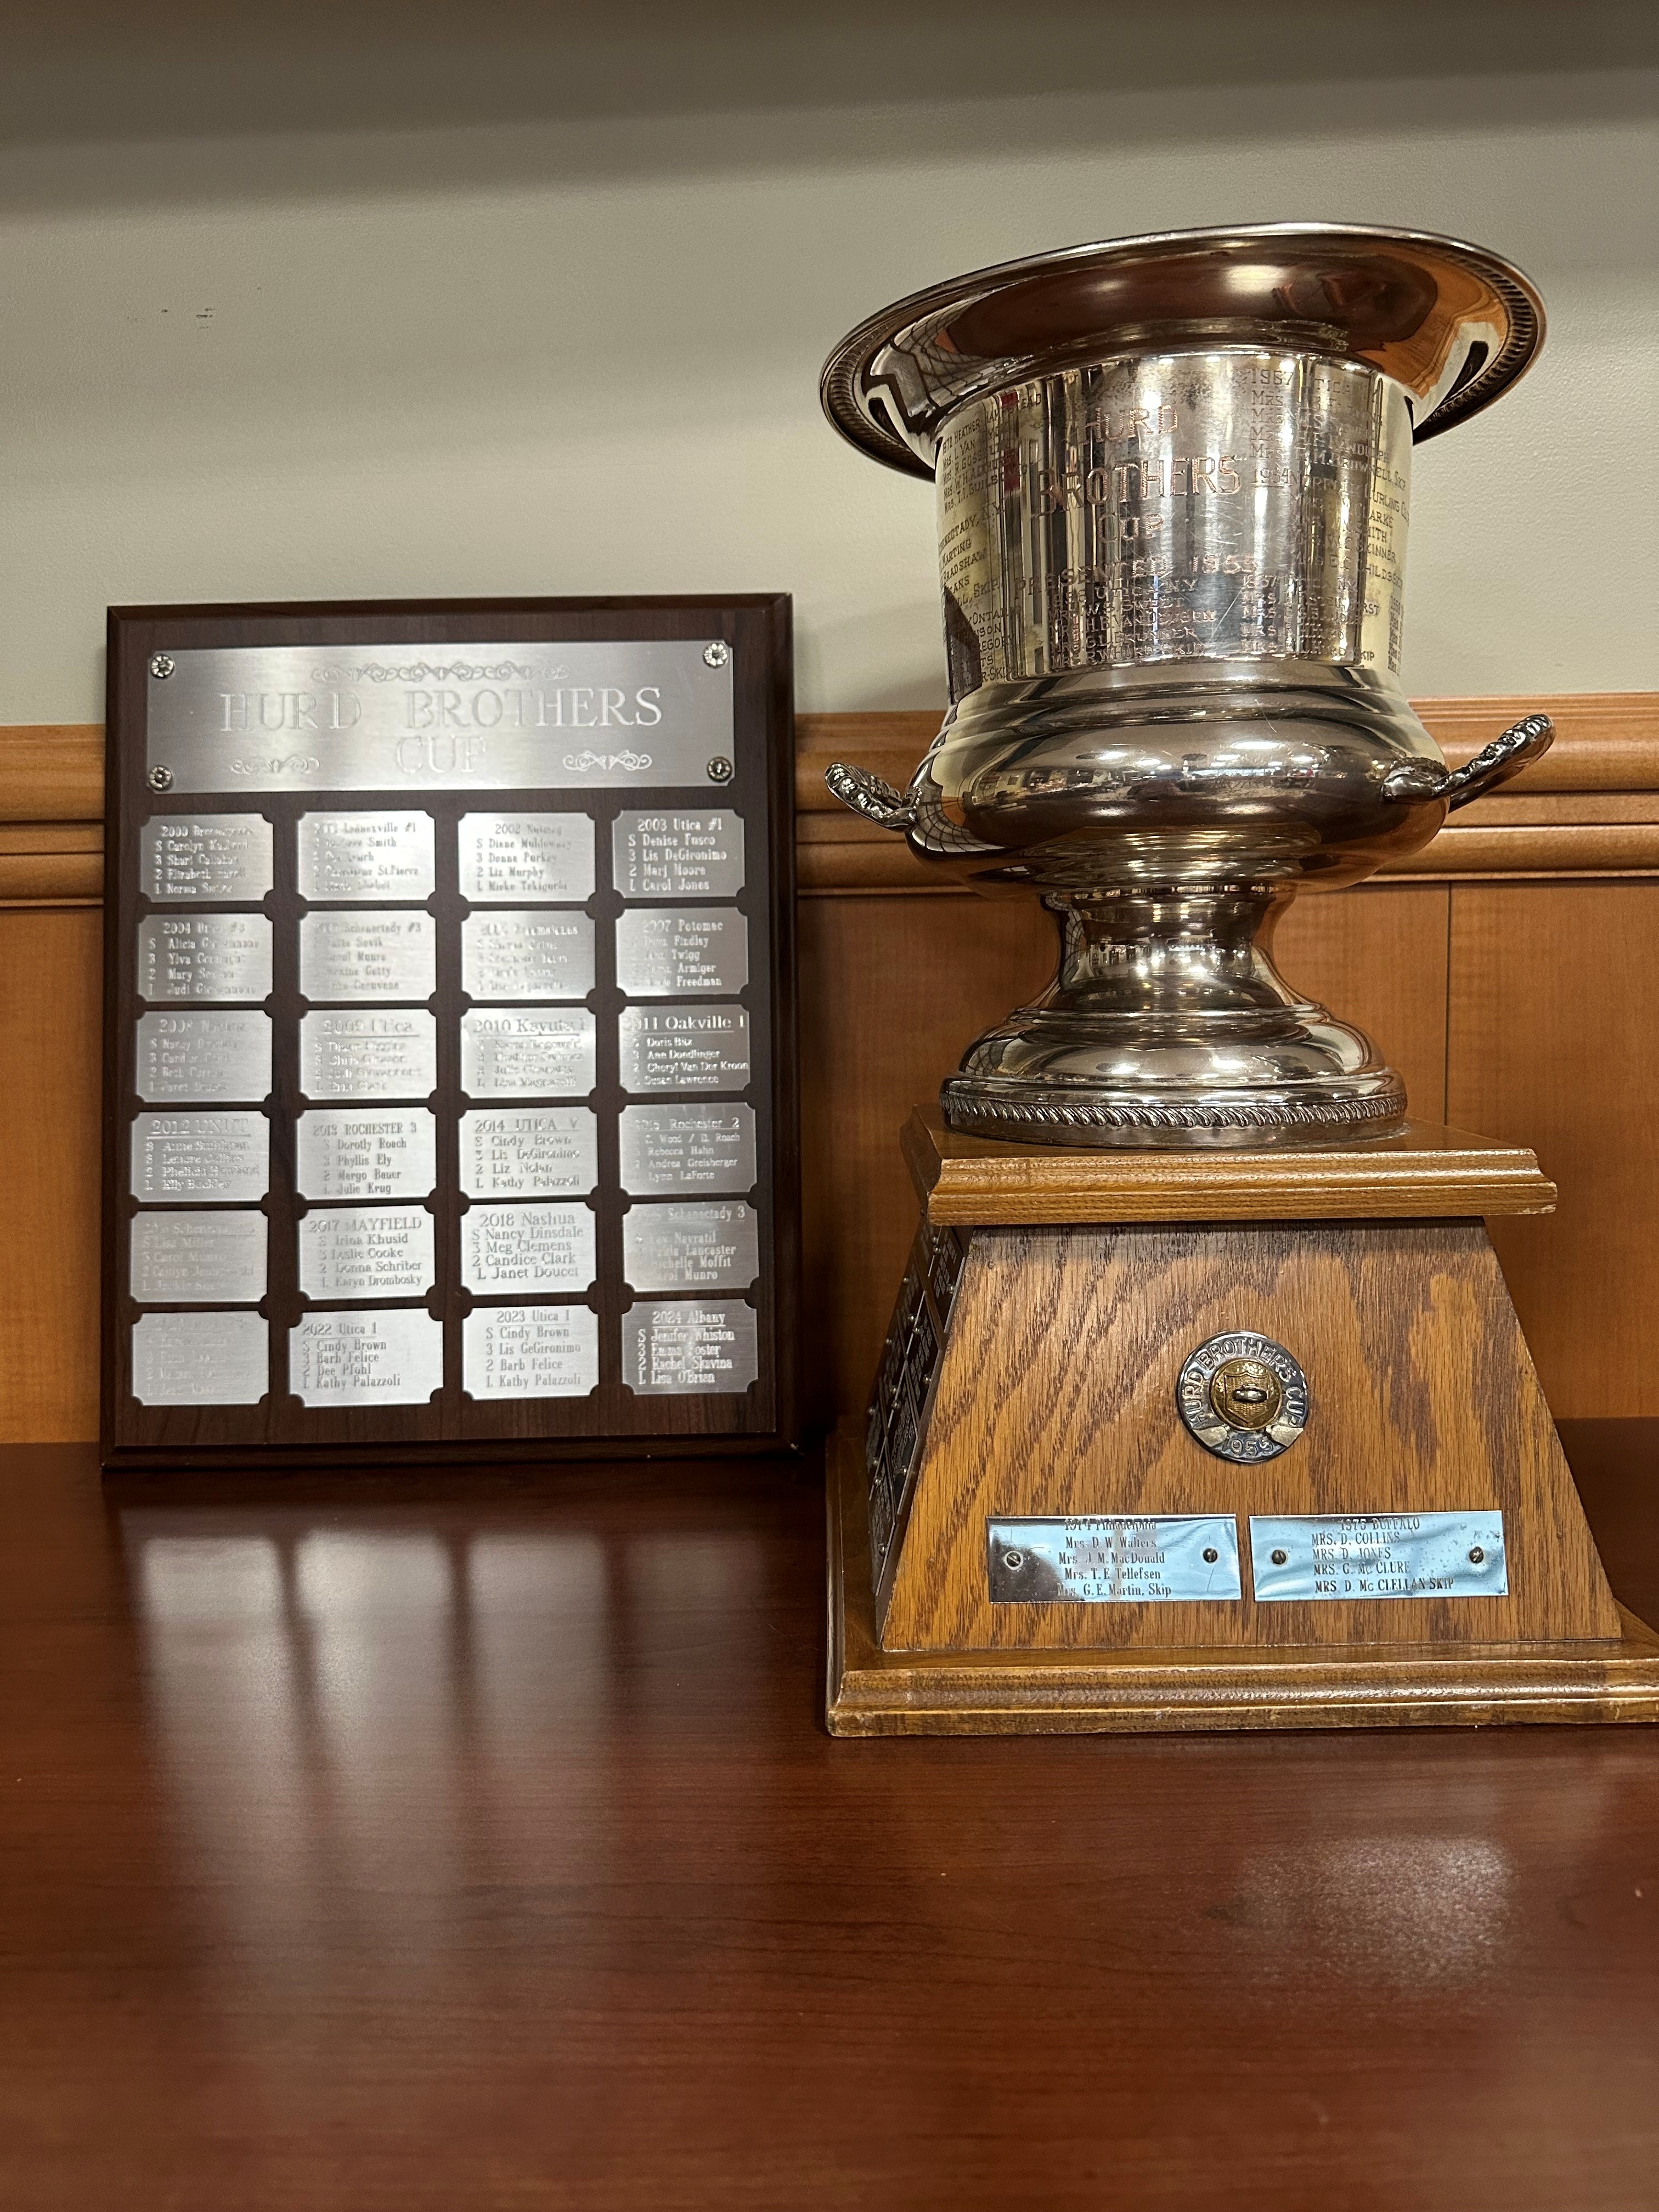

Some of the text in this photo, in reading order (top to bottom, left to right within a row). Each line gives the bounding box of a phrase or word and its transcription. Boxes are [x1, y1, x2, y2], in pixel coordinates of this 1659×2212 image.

[1081, 405, 1178, 445] HURD
[1031, 454, 1242, 518] BROTHERS
[1099, 512, 1164, 542] CUP
[1014, 552, 1259, 599] PRESENTED 1955
[219, 687, 662, 732] HURD BROTHERS
[396, 734, 488, 774] CUP
[161, 825, 189, 838] 2000
[494, 823, 521, 834] 2002
[637, 817, 723, 832] 2003 Utica #1
[368, 837, 397, 848] Smith
[489, 838, 515, 849] Diane
[642, 833, 716, 847] Denise Fusco
[489, 852, 518, 863] Donna
[642, 848, 727, 862] Lis DeGironimo
[489, 866, 545, 881] Liz Murphy
[643, 862, 706, 878] Marj Moore
[642, 877, 710, 891] Carol Jones
[678, 918, 724, 932] Potomac
[674, 934, 709, 949] Findlay
[671, 949, 701, 962] Twigg
[168, 967, 193, 982] Mary
[678, 962, 716, 975] Armiger
[676, 975, 723, 987] Freedman
[473, 1019, 512, 1033] 2010
[665, 1015, 732, 1030] Oakville
[646, 1037, 673, 1047] Doris
[647, 1051, 667, 1059] Ann
[680, 1062, 699, 1072] Van
[700, 1062, 718, 1071] Der
[720, 1060, 750, 1070] Kroon
[674, 1074, 719, 1085] Lawrence
[345, 1122, 403, 1136] ROCHESTER
[475, 1118, 558, 1132] 2014 UTICA
[669, 1118, 723, 1130] Rochester
[379, 1137, 407, 1149] Roach
[492, 1134, 572, 1148] Cindy Brown
[659, 1133, 682, 1144] Wood
[492, 1147, 580, 1161] Lis DeGironimo
[648, 1146, 715, 1156] Rebecca Hahn
[337, 1153, 392, 1167] Phyllis Ely
[648, 1159, 681, 1169] Andrea
[493, 1161, 553, 1174] Liz Nolan
[338, 1168, 402, 1183] Margo Bauer
[492, 1175, 580, 1189] Kathy Palazzoli
[680, 1170, 715, 1180] LaForte
[367, 1182, 392, 1195] Krug
[479, 1211, 575, 1227] 2018 Nashua
[668, 1205, 732, 1222] Schenectady
[308, 1216, 422, 1233] 2017 MAYFIELD
[335, 1232, 409, 1246] Irina Khusid
[486, 1226, 584, 1240] Nancy Dinsdale
[674, 1230, 716, 1244] Navratil
[331, 1247, 404, 1260] Leslie Cooke
[486, 1239, 572, 1255] Meg Clemens
[685, 1243, 737, 1256] Lancaster
[485, 1251, 577, 1266] Candice Clark
[335, 1260, 422, 1273] Donna Schriber
[492, 1265, 579, 1279] Janet Doucet
[685, 1267, 718, 1280] Munro
[368, 1273, 422, 1286] Drombosky
[496, 1309, 558, 1323] 2023 Utica
[652, 1310, 726, 1325] 2024 Albany
[302, 1322, 365, 1336] 2022 Utica
[499, 1325, 570, 1341] Cindy Brown
[317, 1338, 387, 1355] Cindy Brown
[499, 1342, 515, 1355] Lis
[651, 1342, 683, 1357] Emma
[317, 1350, 380, 1364] Barb Felice
[500, 1357, 563, 1371] Barb Felice
[652, 1355, 733, 1370] Rachel Skavina
[317, 1364, 336, 1376] Dee
[651, 1369, 715, 1384] Lisa O'Brien
[317, 1373, 401, 1391] Kathy Palazzoli
[499, 1373, 582, 1390] Kathy Palazzoli
[1182, 1337, 1305, 1430] HURD BROTHERS CUP
[1221, 1436, 1274, 1457] 1955
[1096, 1518, 1157, 1533] Philadelphia
[1371, 1516, 1420, 1531] BUFFALO
[1119, 1536, 1157, 1549] Walters
[1311, 1531, 1400, 1546] MRS. D. COLLINS
[1110, 1551, 1165, 1564] MacDonald
[1357, 1546, 1391, 1560] JONES
[1064, 1567, 1161, 1581] Mrs. T. Tellefsen
[1313, 1562, 1339, 1576] MRS.
[1375, 1560, 1410, 1574] CLURE
[1083, 1583, 1095, 1596] G.
[1096, 1583, 1107, 1596] E.
[1148, 1582, 1172, 1599] Skip
[1378, 1577, 1425, 1591] CLELLAN
[1429, 1576, 1454, 1590] SKIP
